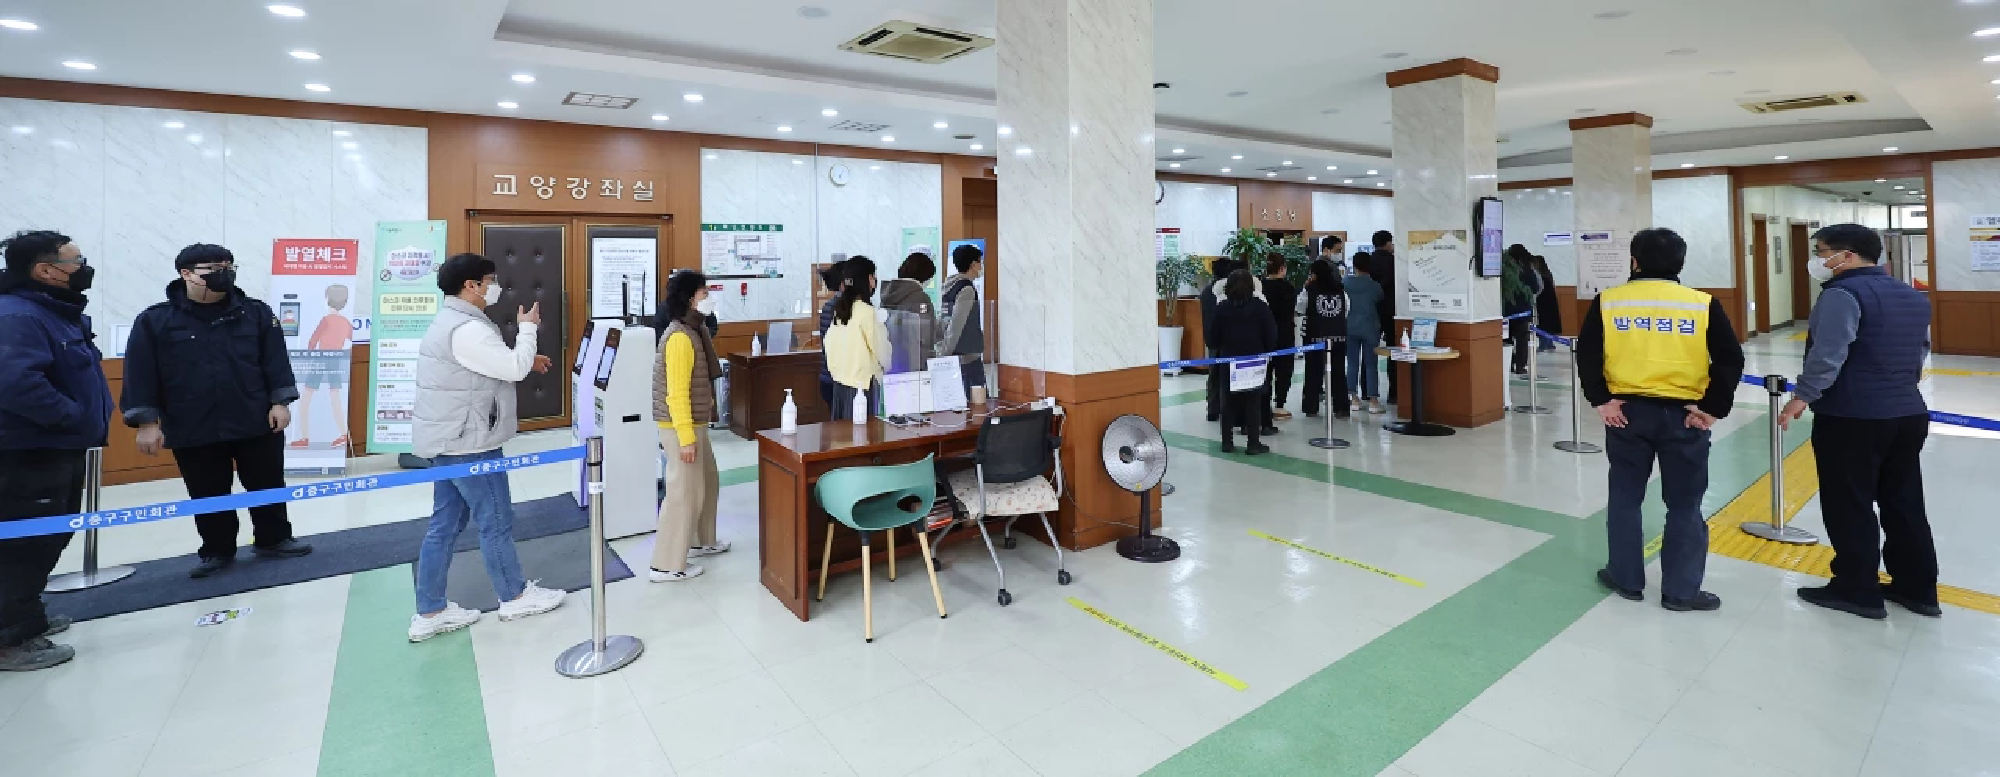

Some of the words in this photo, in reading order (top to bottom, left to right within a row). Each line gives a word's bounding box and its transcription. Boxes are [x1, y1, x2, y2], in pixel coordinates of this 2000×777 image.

[492, 173, 654, 201] 교양강좌실
[285, 246, 347, 261] 발열체크
[1613, 316, 1695, 334] 방역점검
[306, 477, 378, 497] 중구구민회관
[87, 504, 177, 526] 중구구민회관
